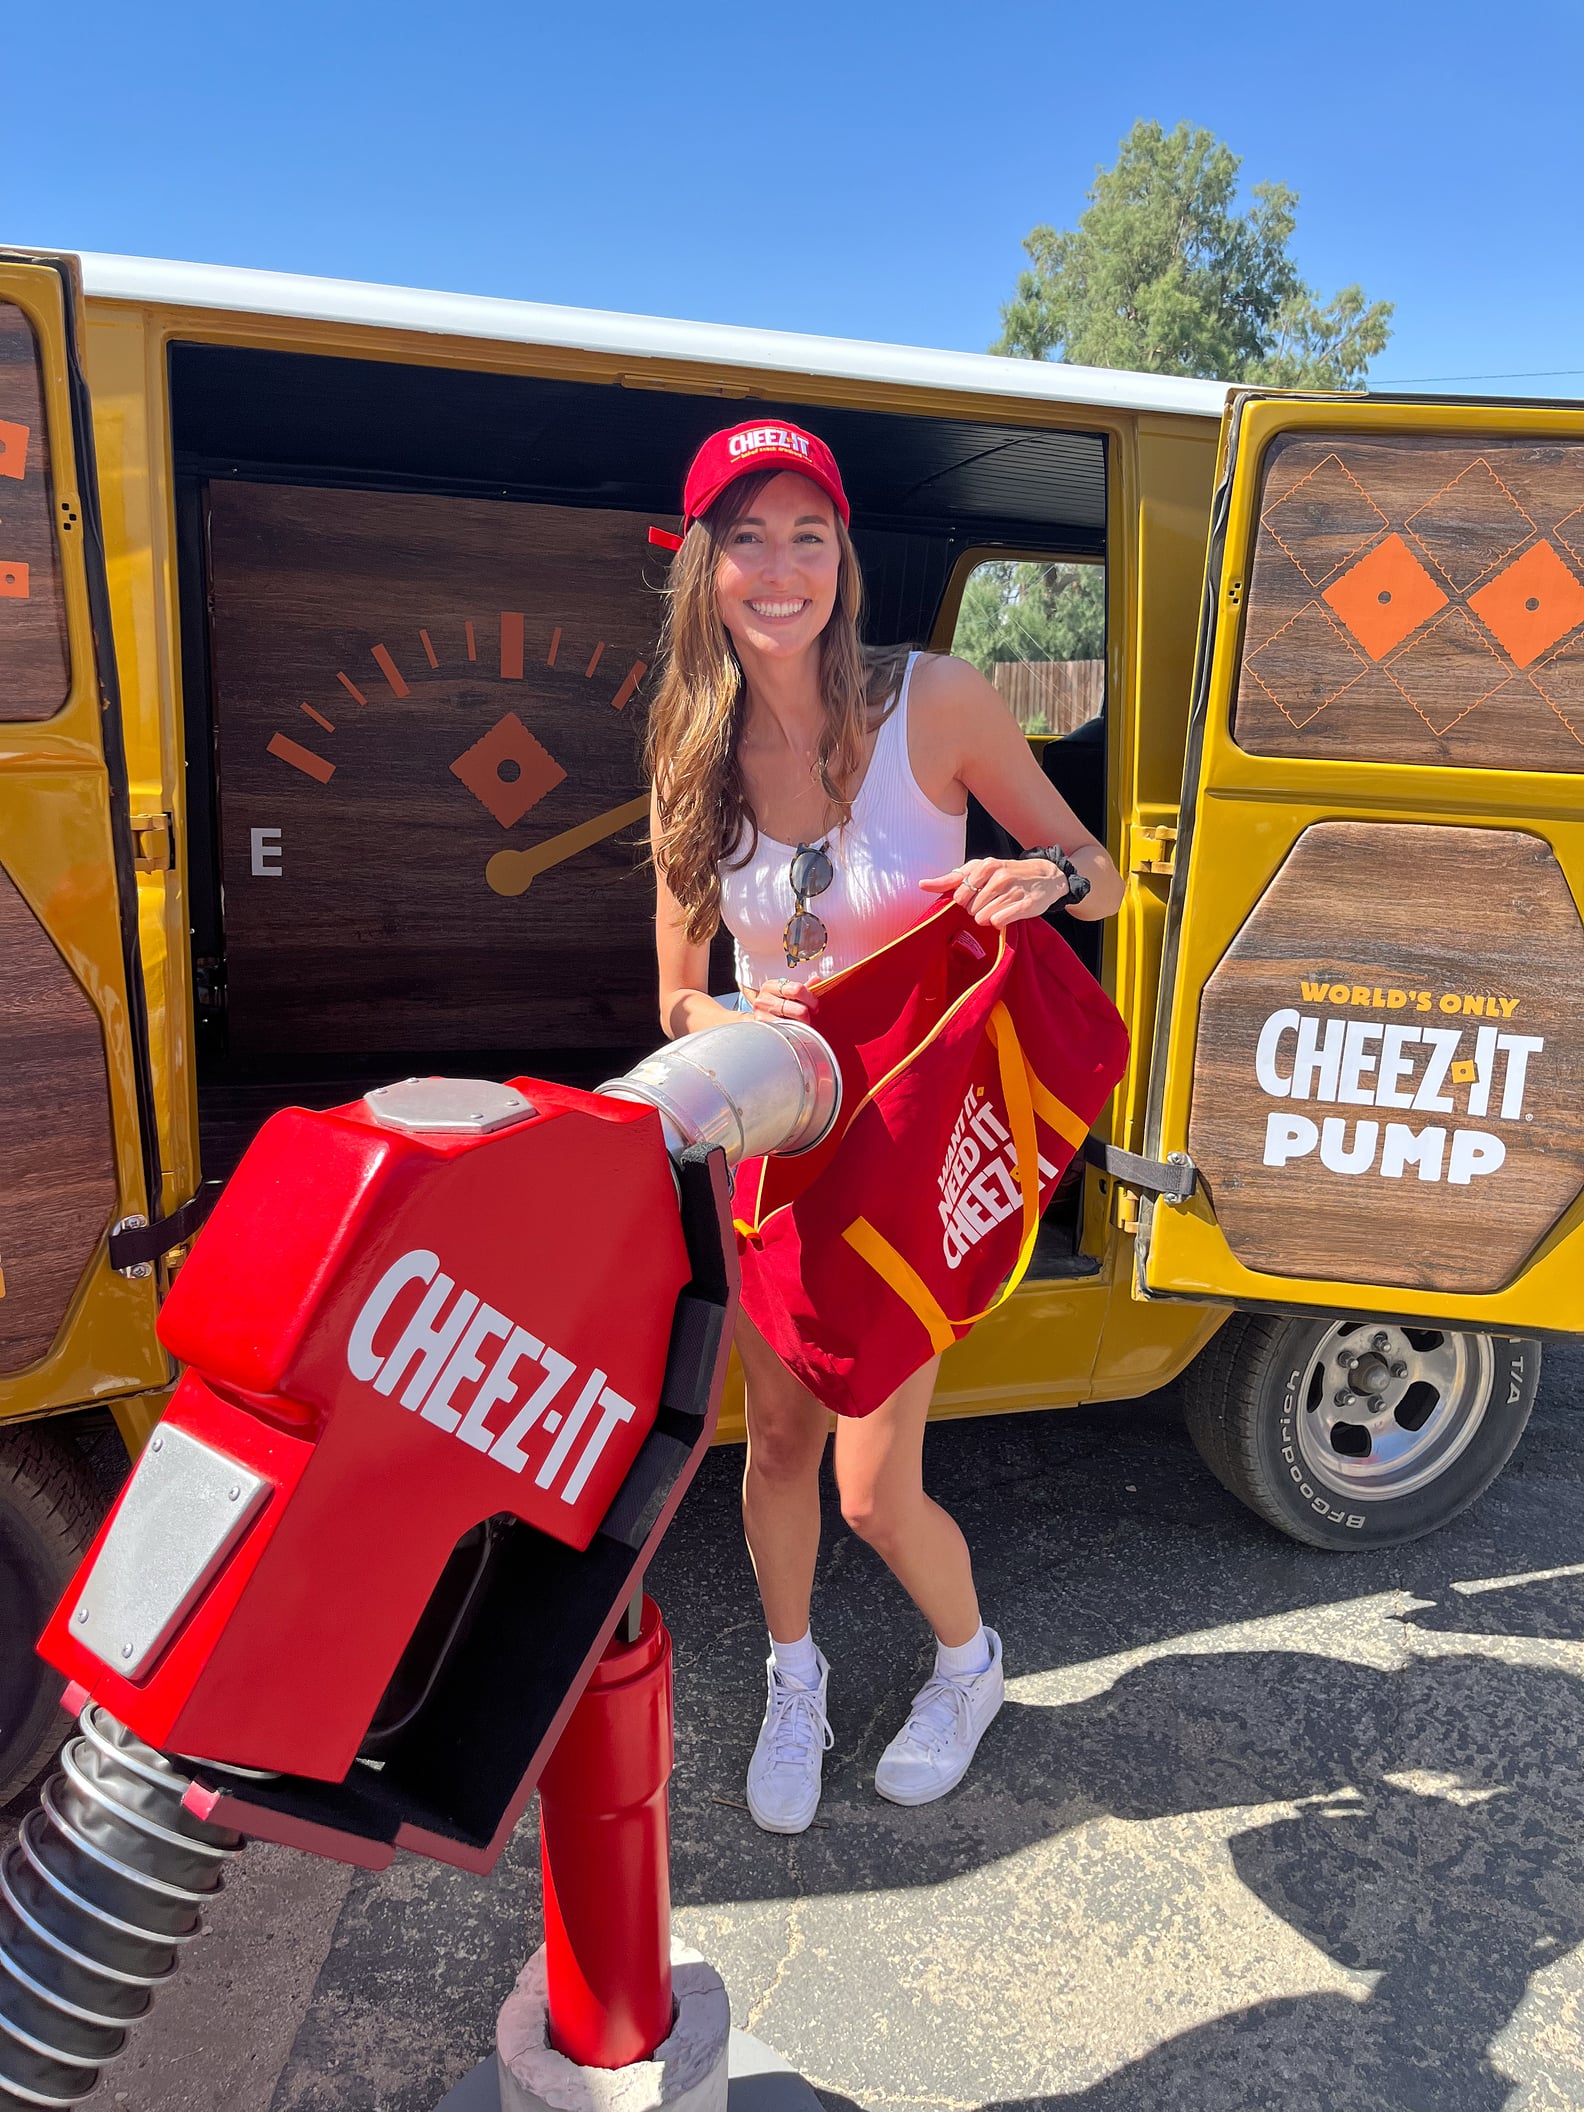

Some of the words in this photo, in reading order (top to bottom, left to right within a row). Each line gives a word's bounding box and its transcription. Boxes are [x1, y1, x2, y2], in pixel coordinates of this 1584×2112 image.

[728, 428, 809, 457] CHEEZ-IT
[250, 827, 283, 877] E
[1300, 981, 1433, 1012] WORLD'S
[1439, 994, 1521, 1018] ONLY
[1255, 1008, 1545, 1120] CHEEZ-IT
[937, 1107, 966, 1192] WANT
[938, 1136, 981, 1229] NEED
[969, 1101, 1010, 1152] IT
[1262, 1112, 1507, 1185] PUMP
[347, 1248, 637, 1506] CHEEZ-IT
[1506, 1355, 1524, 1405] T/A
[1279, 1369, 1367, 1530] BFGoodrich
